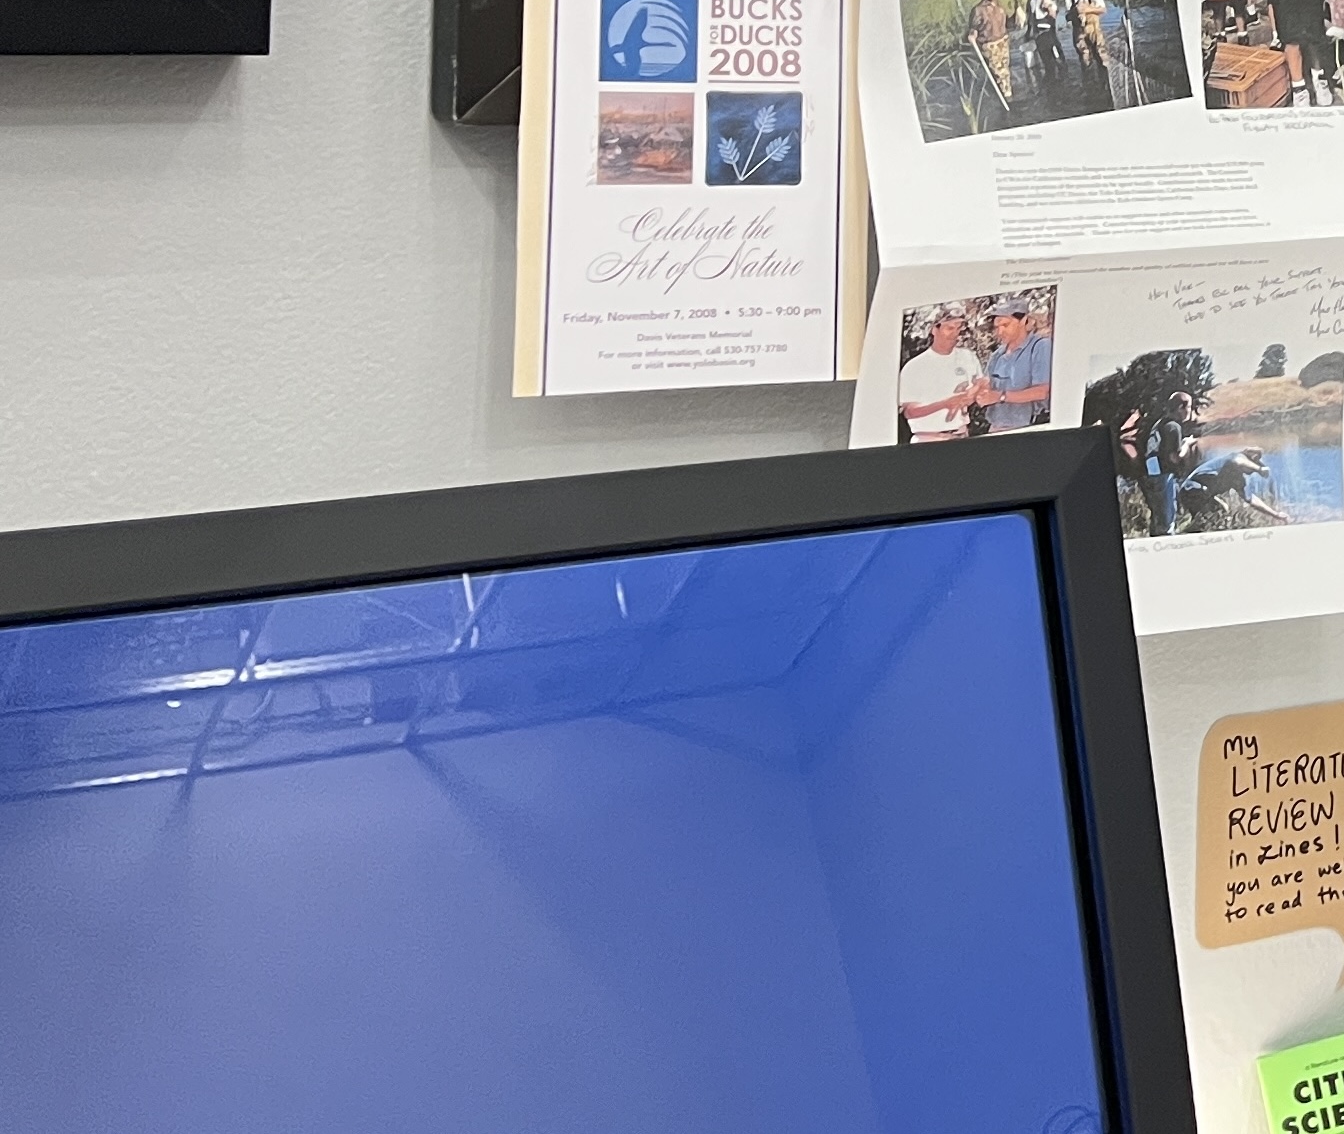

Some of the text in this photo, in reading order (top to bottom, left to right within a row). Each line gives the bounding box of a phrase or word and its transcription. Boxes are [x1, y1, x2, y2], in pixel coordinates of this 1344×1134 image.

[720, 25, 802, 47] DUCKS
[708, 48, 801, 78] 2008
[619, 206, 774, 244] Celebrate the
[586, 241, 804, 295] Art of Nature
[563, 308, 717, 325] Friday, November 7, 2008
[738, 306, 821, 320] 5:30 9:00 pm
[1228, 790, 1335, 840] REVIEW
[1229, 835, 1324, 870] in zines
[1227, 877, 1260, 907] you
[1271, 869, 1304, 886] are
[1224, 905, 1247, 924] to
[1256, 890, 1303, 917] read
